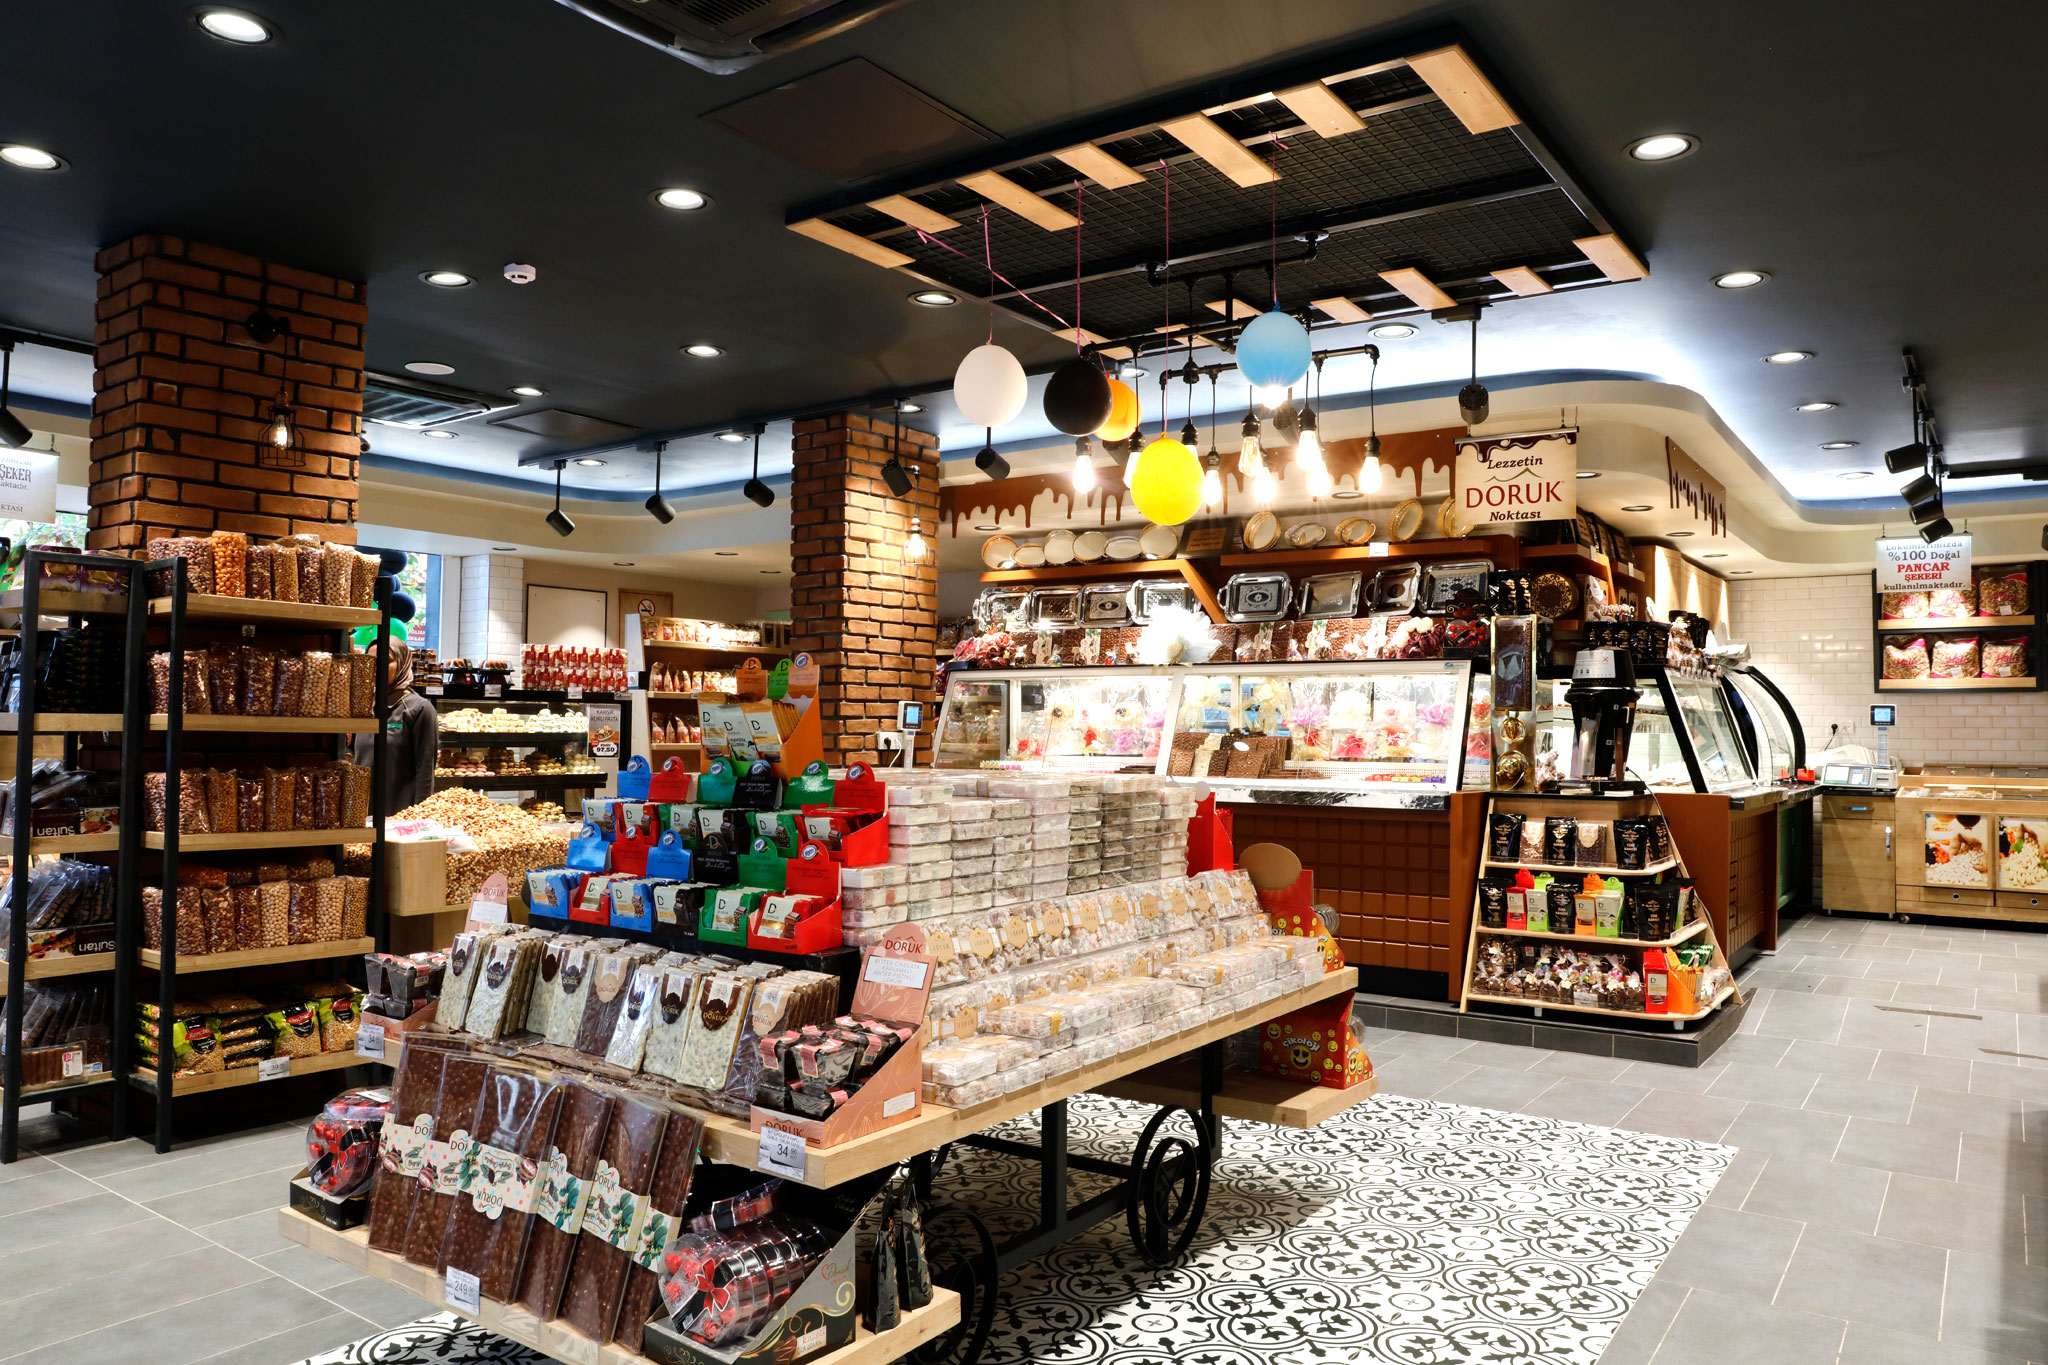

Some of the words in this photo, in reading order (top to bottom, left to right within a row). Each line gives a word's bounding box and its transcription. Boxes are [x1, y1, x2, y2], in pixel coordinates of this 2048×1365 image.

[1487, 455, 1543, 470] Lezzetin
[1466, 480, 1562, 508] DORUK
[1489, 510, 1541, 521] Noktası
[1888, 550, 1927, 562] %100
[1930, 550, 1960, 561] Doğal
[1897, 562, 1950, 573] PANCAR
[1904, 570, 1942, 582] ŞEKERİ
[1883, 581, 1966, 591] kullanılmaktadır.
[702, 711, 711, 722] D
[724, 721, 733, 731] D
[751, 720, 760, 730] D
[674, 812, 681, 822] D
[702, 817, 710, 827] D
[37, 824, 75, 837] Sultan
[759, 820, 767, 830] D
[809, 824, 817, 834] D
[616, 889, 623, 899] D
[656, 895, 664, 905] D
[718, 898, 726, 909] D
[767, 903, 777, 914] D
[79, 940, 116, 952] Sultan
[885, 940, 923, 953] DORUK
[703, 1012, 728, 1023] DORUK
[368, 1033, 375, 1044] 34
[270, 1063, 279, 1071] 39
[777, 1143, 788, 1157] 34
[594, 1173, 617, 1191] DORUK
[477, 1190, 503, 1207] DORUK
[454, 1280, 468, 1295] 249
